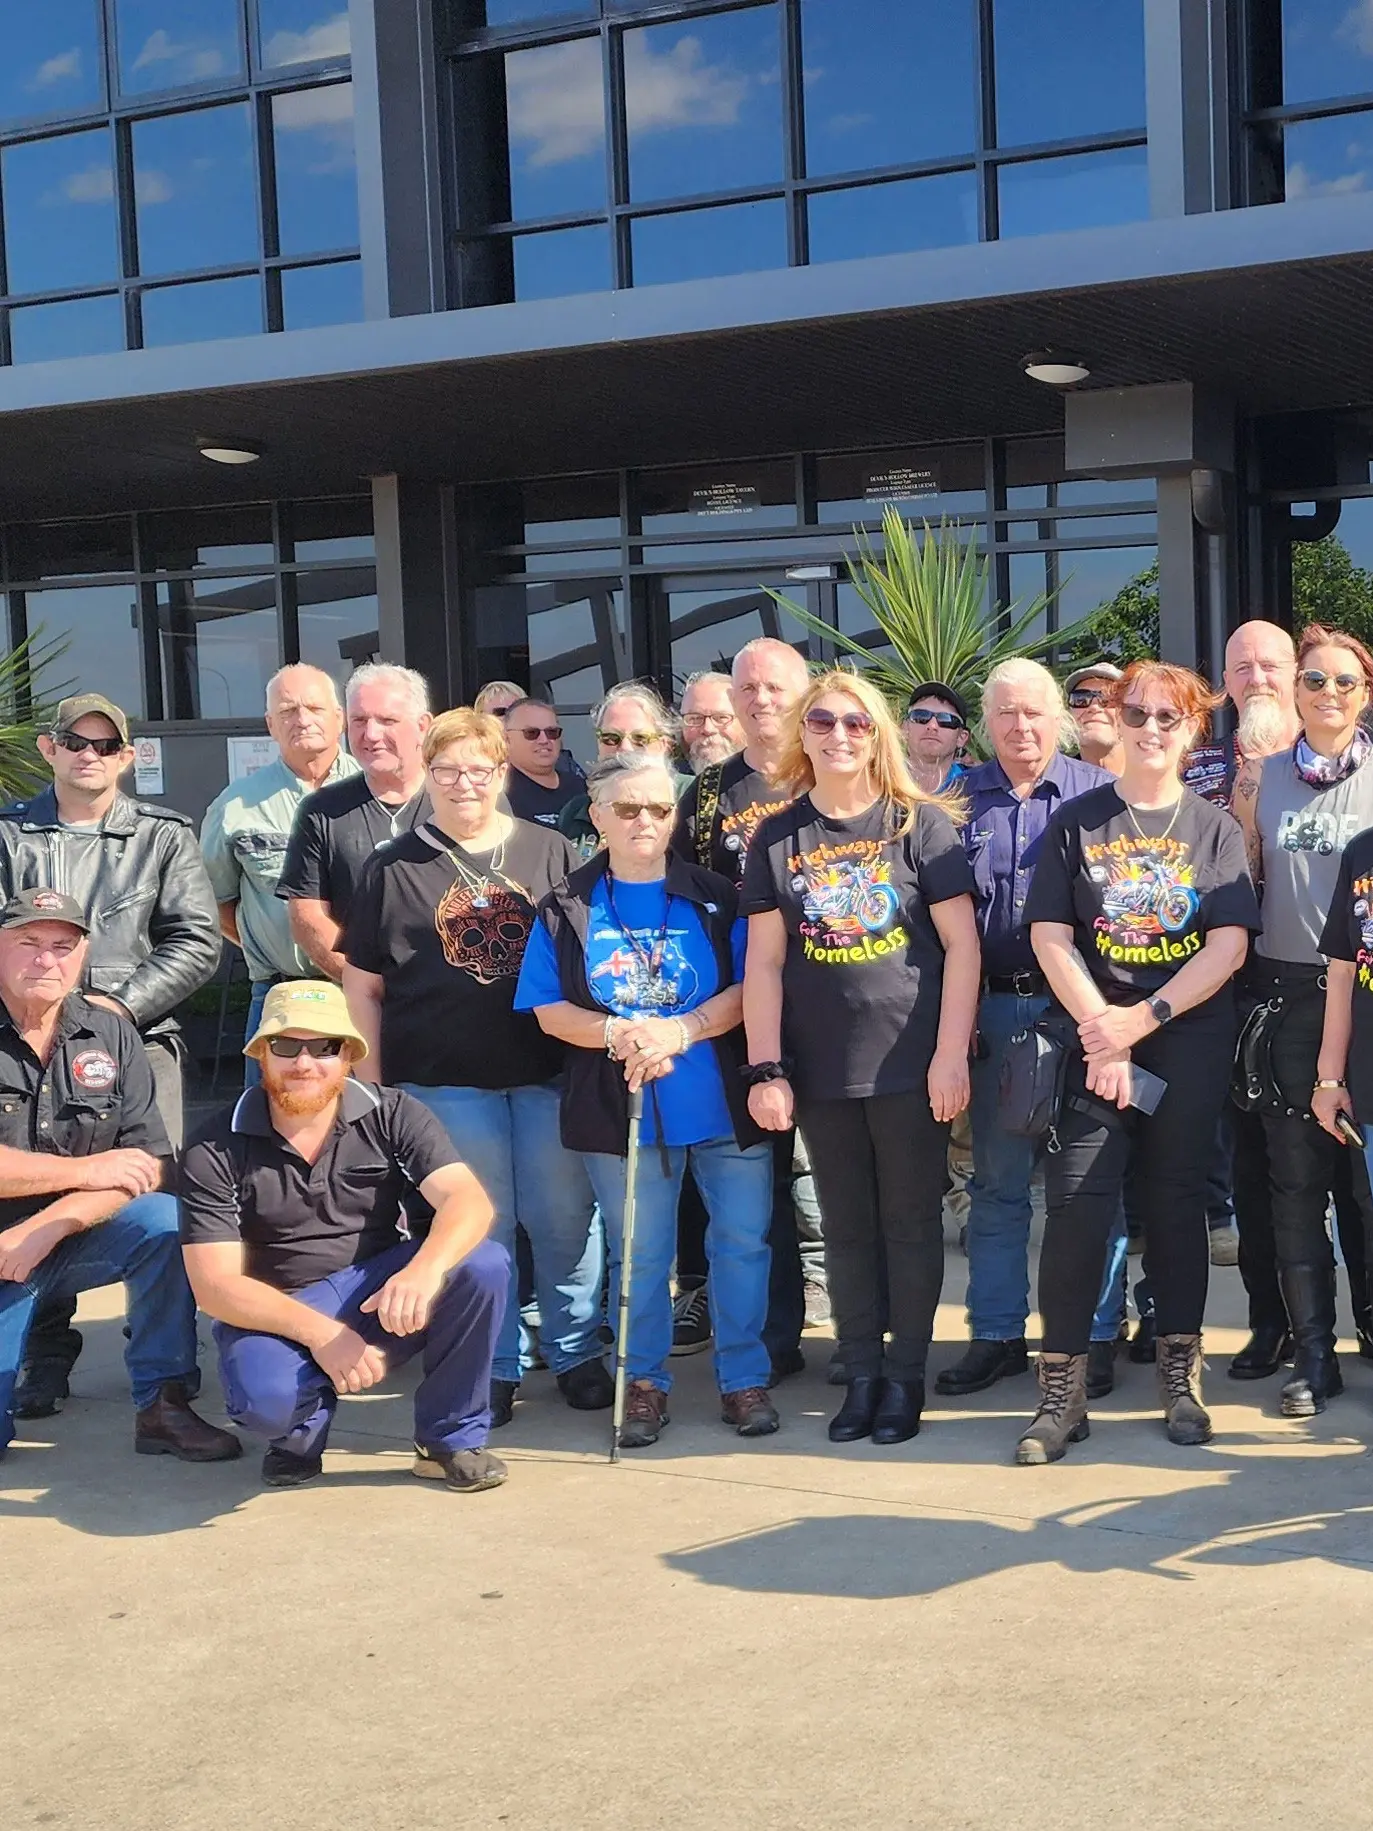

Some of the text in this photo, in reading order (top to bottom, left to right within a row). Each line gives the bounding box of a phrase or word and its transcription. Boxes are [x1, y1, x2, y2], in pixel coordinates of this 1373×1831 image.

[787, 839, 888, 873] Highways
[1085, 833, 1190, 862] Highways
[804, 926, 906, 963] Homeless
[822, 934, 851, 947] The
[1096, 931, 1200, 963] Homeless
[1121, 931, 1150, 945] The
